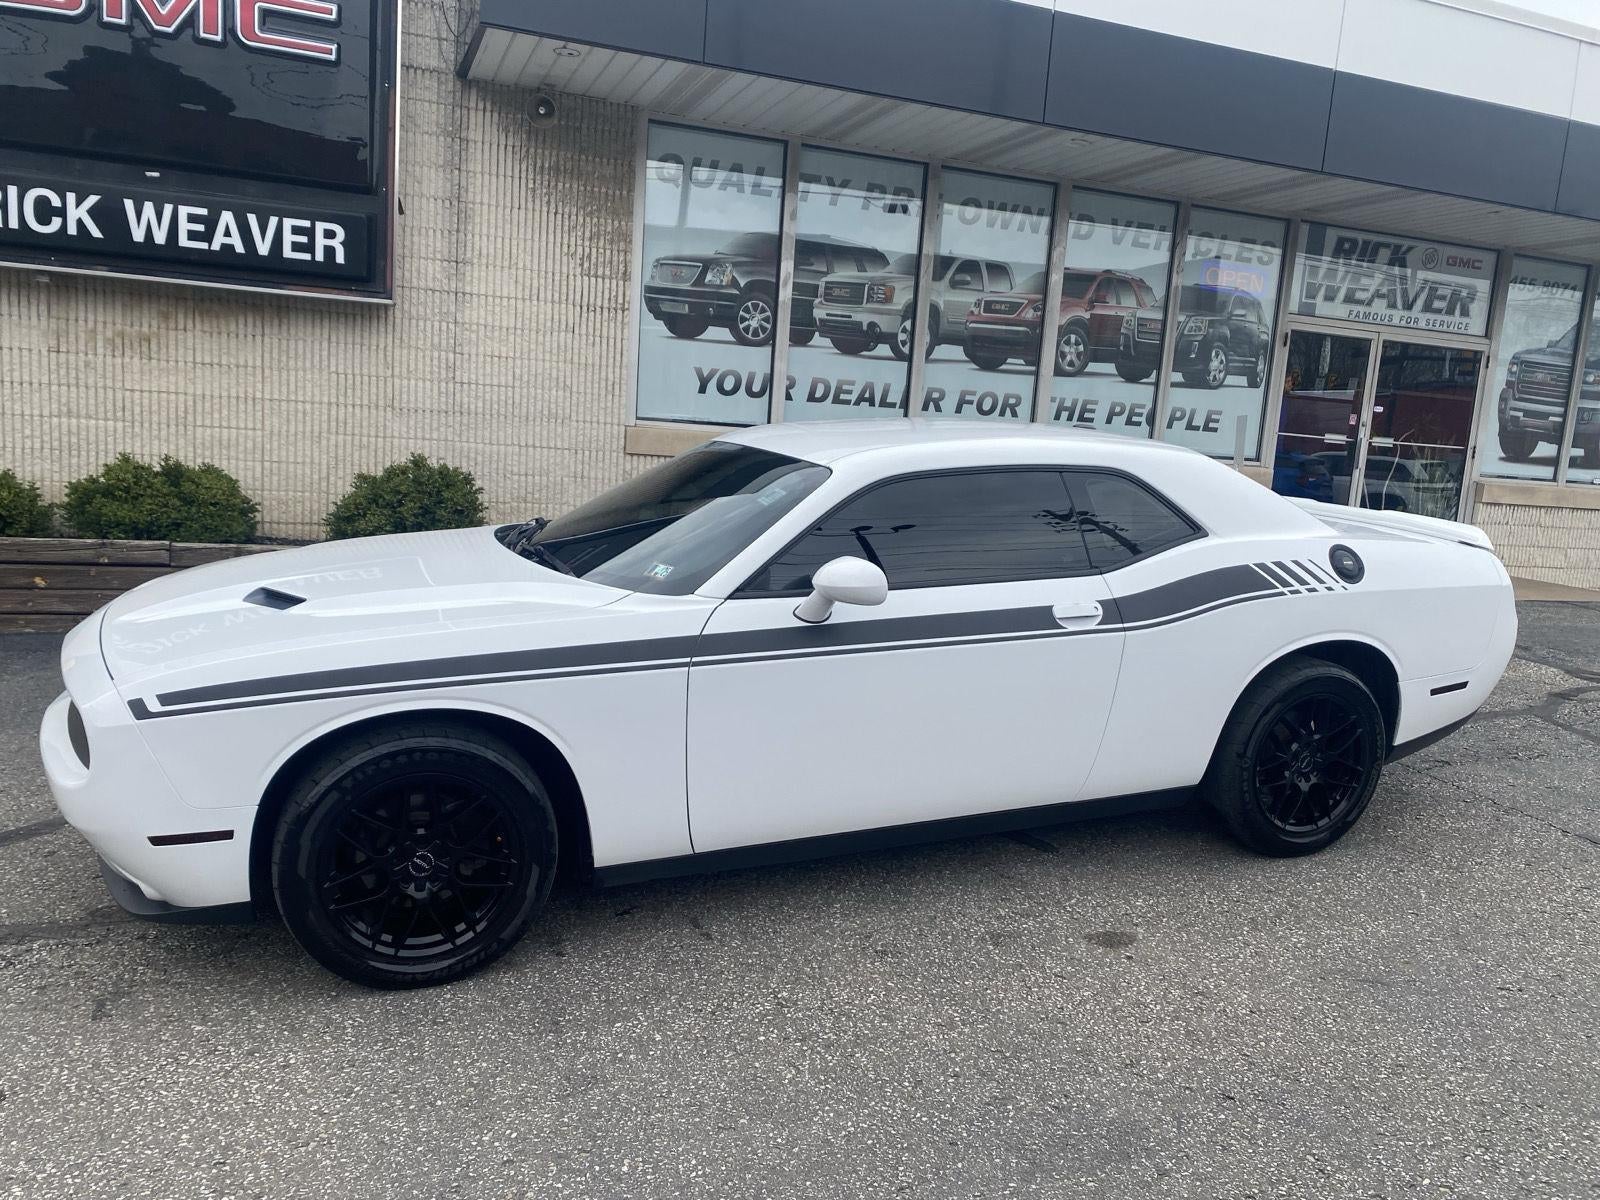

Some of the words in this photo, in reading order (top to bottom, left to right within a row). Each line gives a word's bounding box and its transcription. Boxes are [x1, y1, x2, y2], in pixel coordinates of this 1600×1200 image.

[0, 0, 338, 61] MC
[0, 185, 104, 239] ICK
[123, 198, 345, 264] WEAVER
[655, 152, 853, 206] QUALTY
[861, 182, 1096, 241] PR-OWND
[1111, 217, 1277, 266] VEHCLES
[1328, 236, 1419, 268] RICK
[1446, 256, 1483, 270] GMC
[1206, 267, 1264, 293] OPEN
[1304, 265, 1478, 318] WEAVER
[1347, 309, 1394, 323] FAMOUS
[1400, 316, 1419, 326] FOR
[1424, 318, 1471, 331] SERVICE
[806, 376, 946, 413] DEALR
[954, 389, 1022, 418] FOR
[1050, 396, 1098, 423] HE
